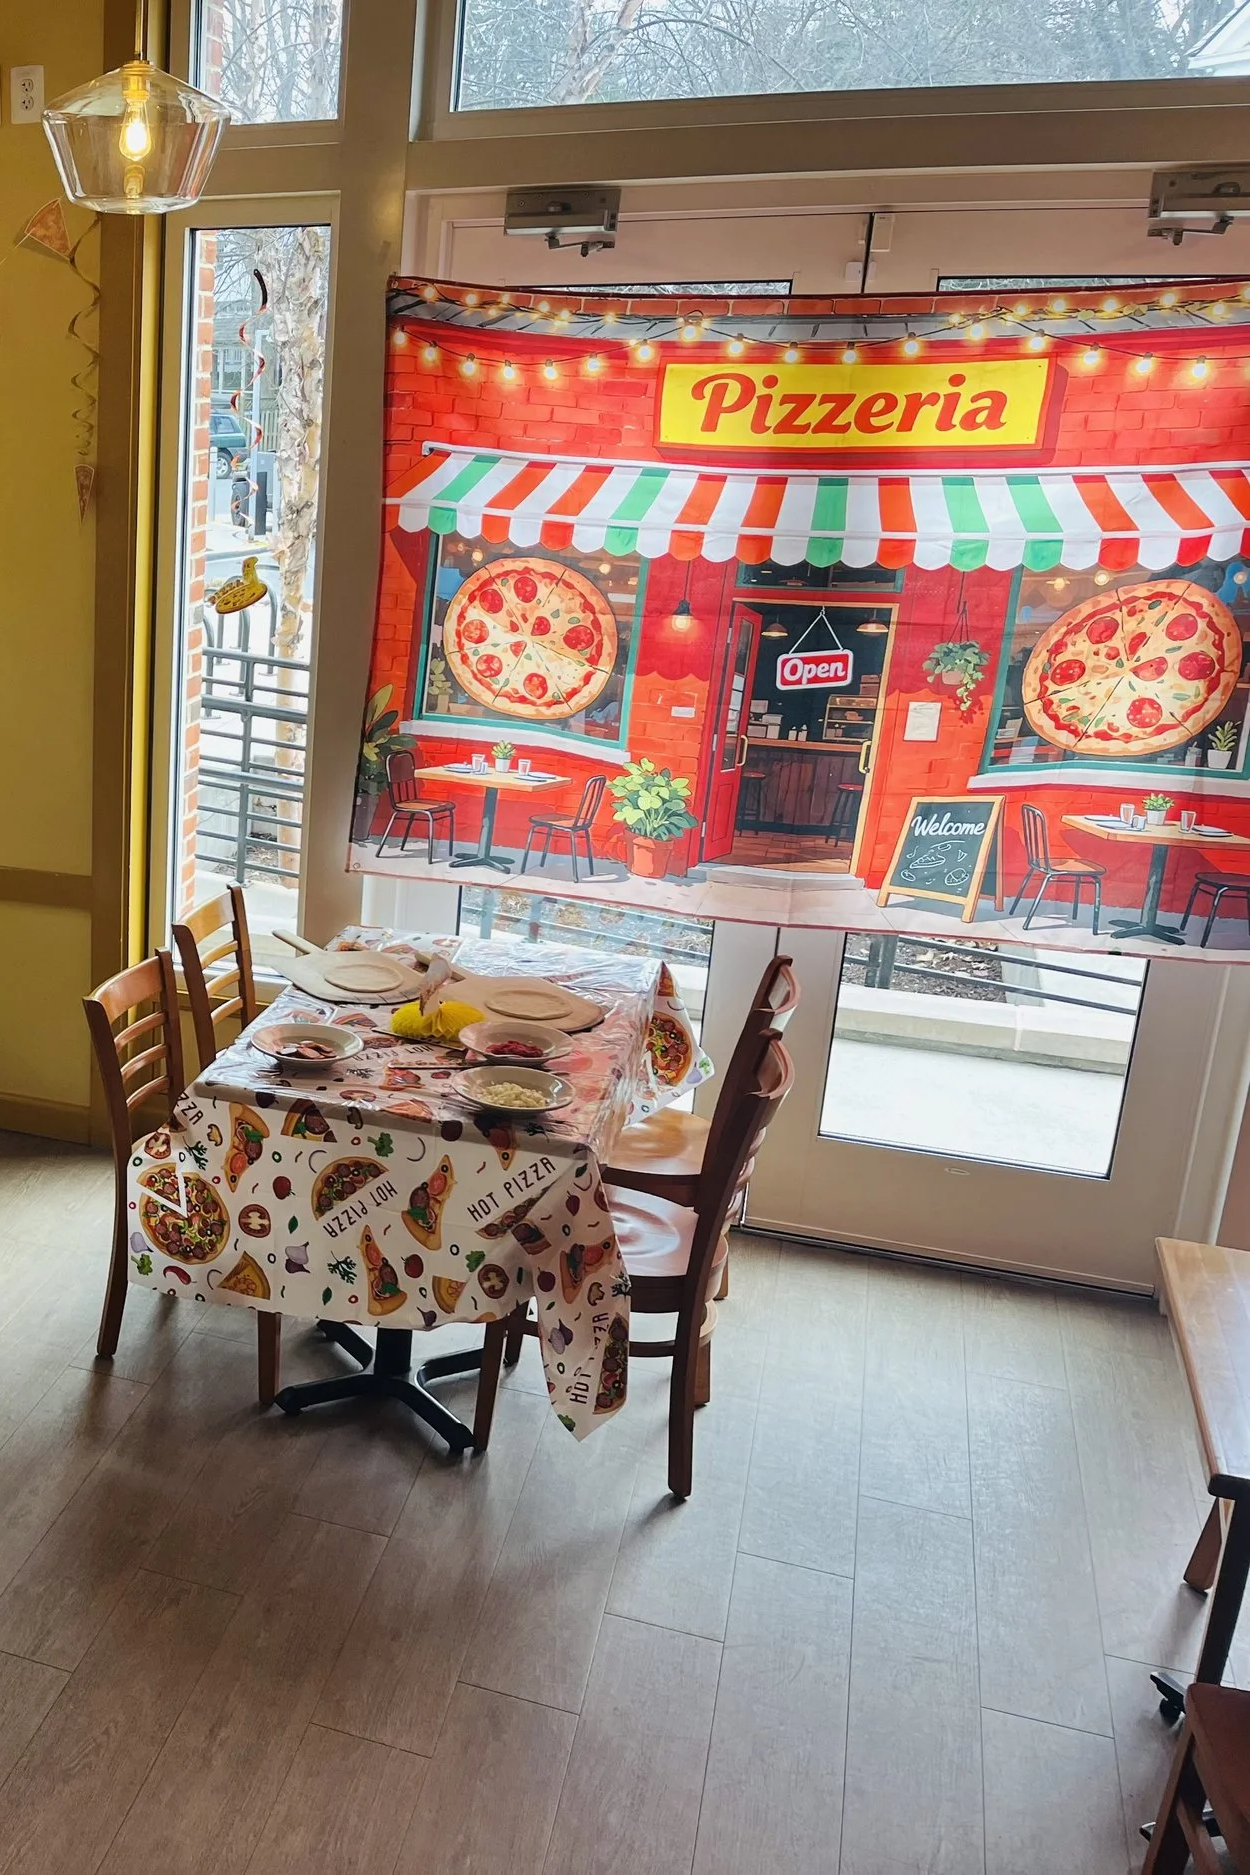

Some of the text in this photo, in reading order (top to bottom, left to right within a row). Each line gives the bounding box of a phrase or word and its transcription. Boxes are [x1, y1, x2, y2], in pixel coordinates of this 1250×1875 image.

[691, 373, 1007, 435] Pizzeria
[783, 658, 846, 685] Open
[911, 812, 986, 837] Welcome
[323, 1181, 398, 1238] HOT PIZZA
[467, 1157, 556, 1222] HOT PIZZA
